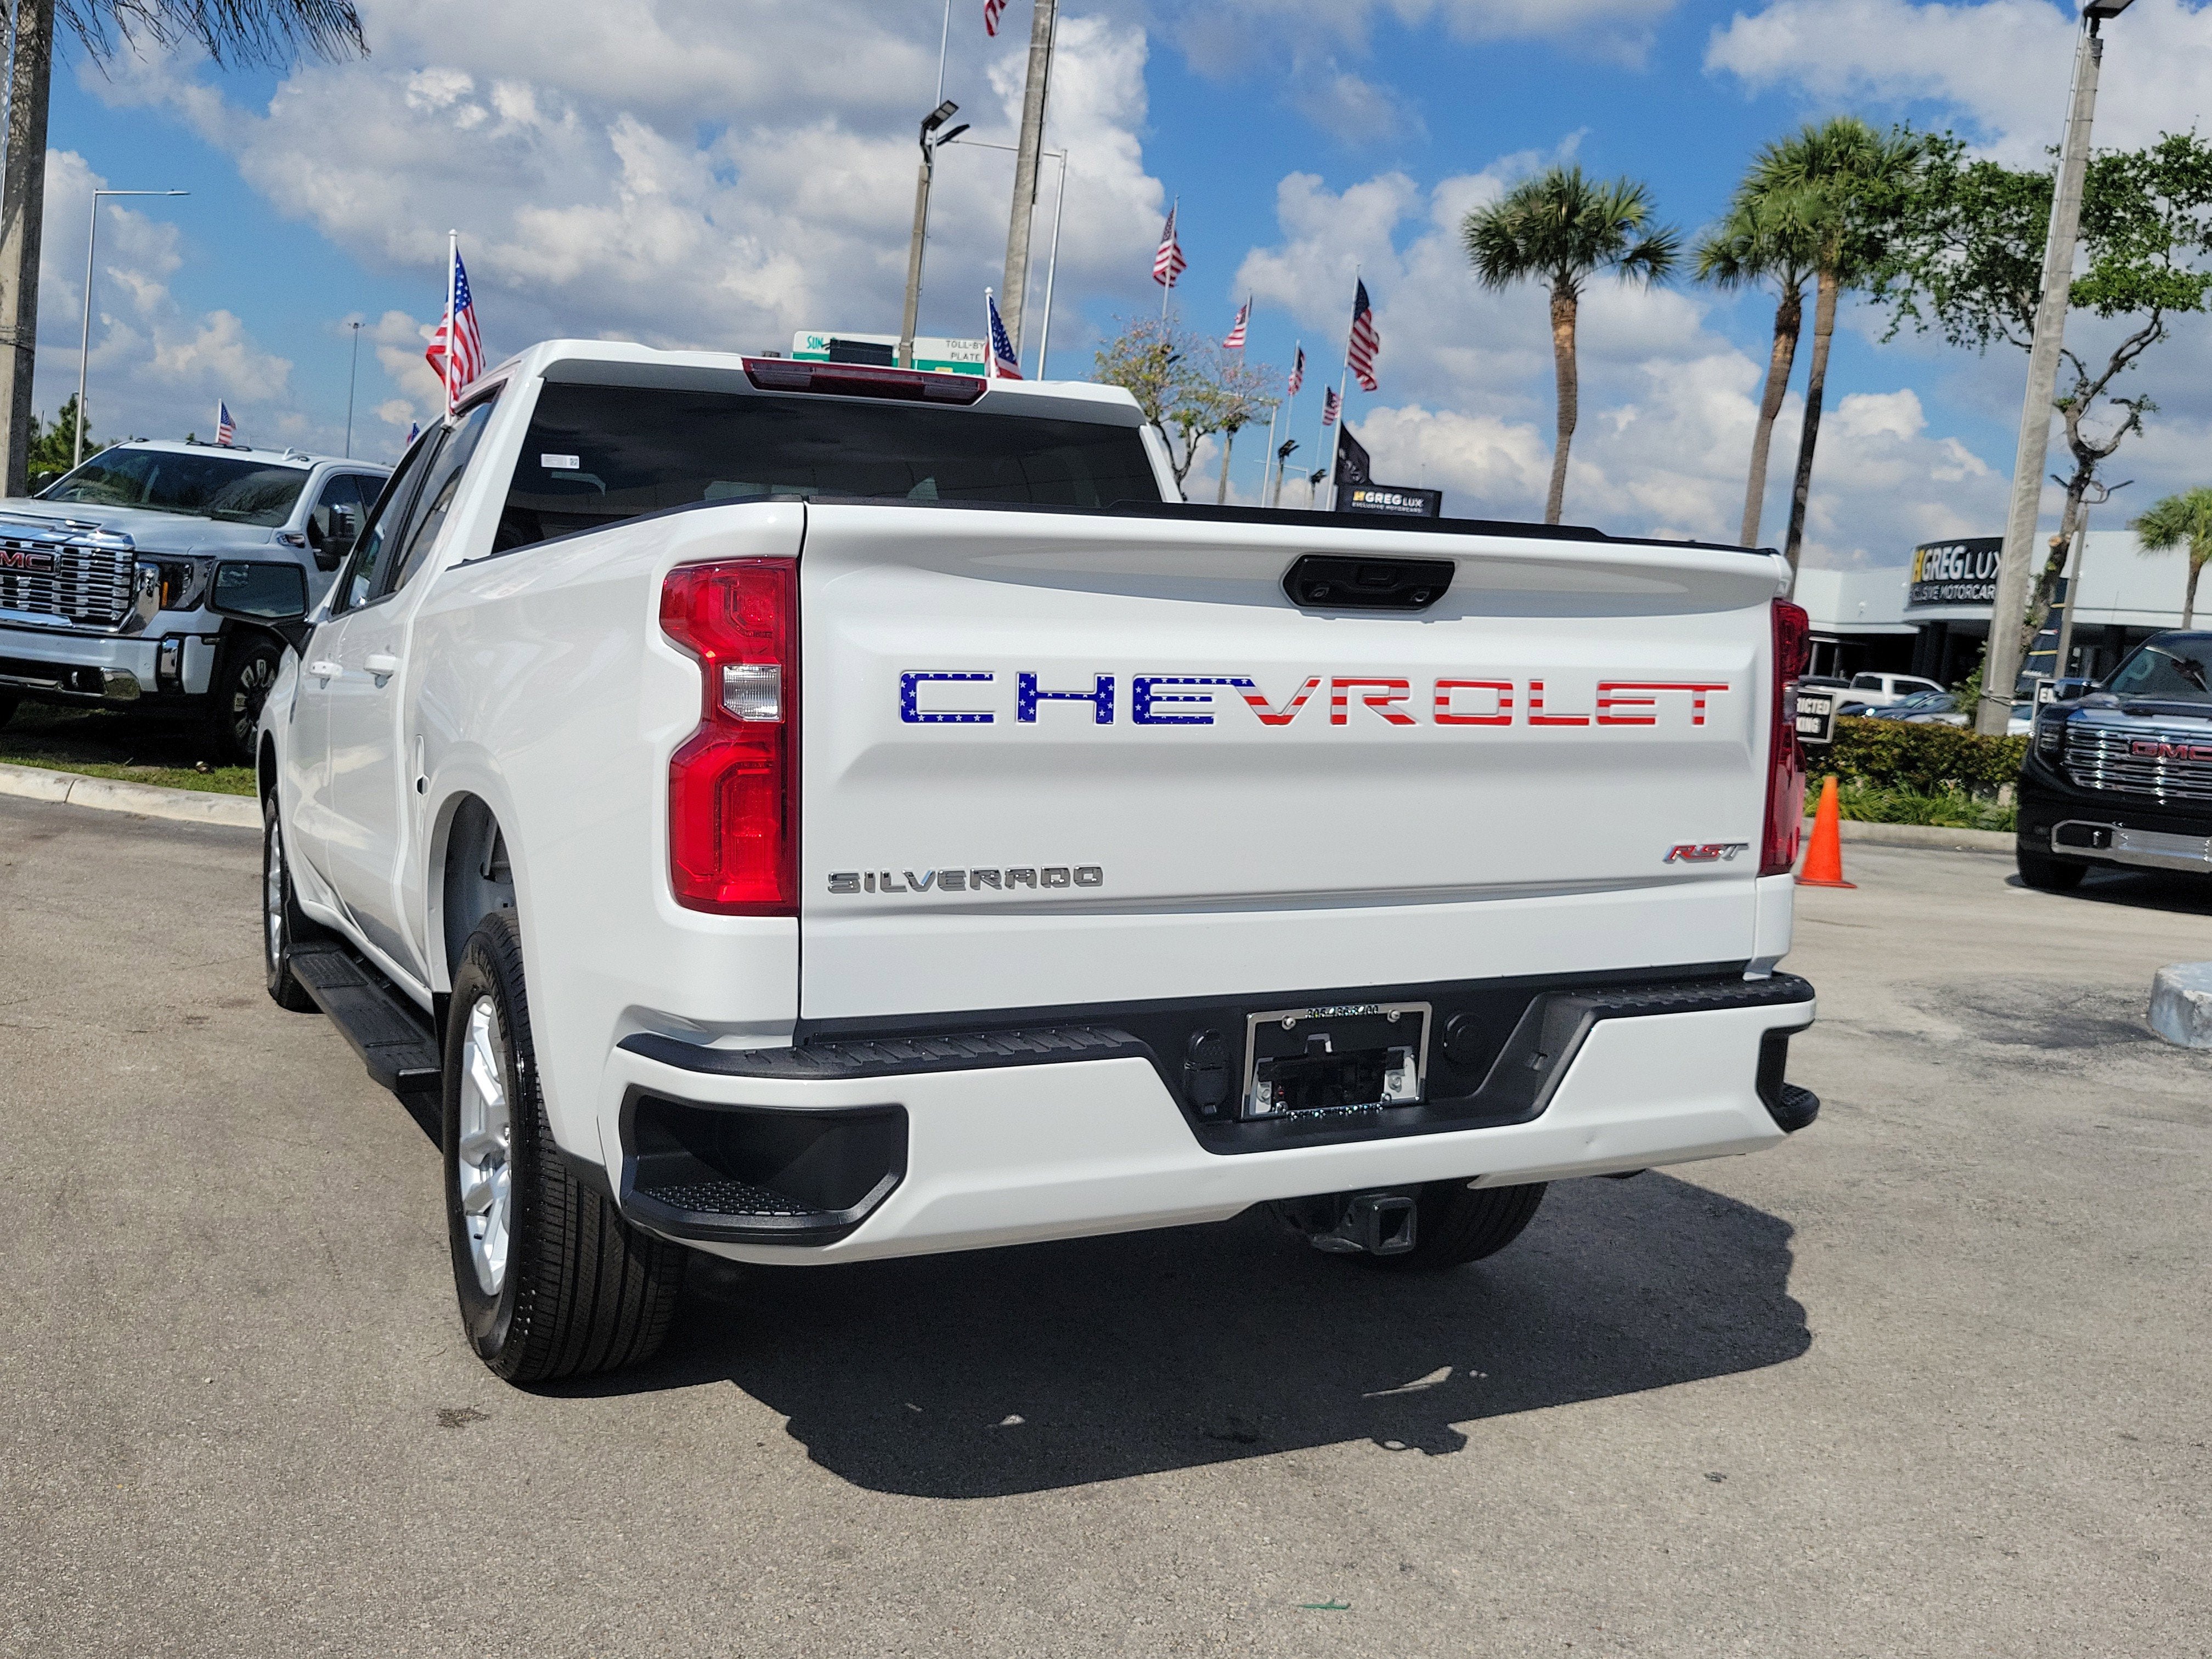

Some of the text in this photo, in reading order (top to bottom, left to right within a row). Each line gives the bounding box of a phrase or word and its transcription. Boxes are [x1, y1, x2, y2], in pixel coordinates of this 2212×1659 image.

[0, 550, 51, 571] MC
[1940, 584, 1996, 600] MOTORCAR
[900, 670, 1729, 725] CHEVROLET
[1796, 716, 1821, 733] KING
[2132, 741, 2212, 761] GMC
[1662, 842, 1749, 864] RST
[827, 866, 1103, 894] SILVERADO
